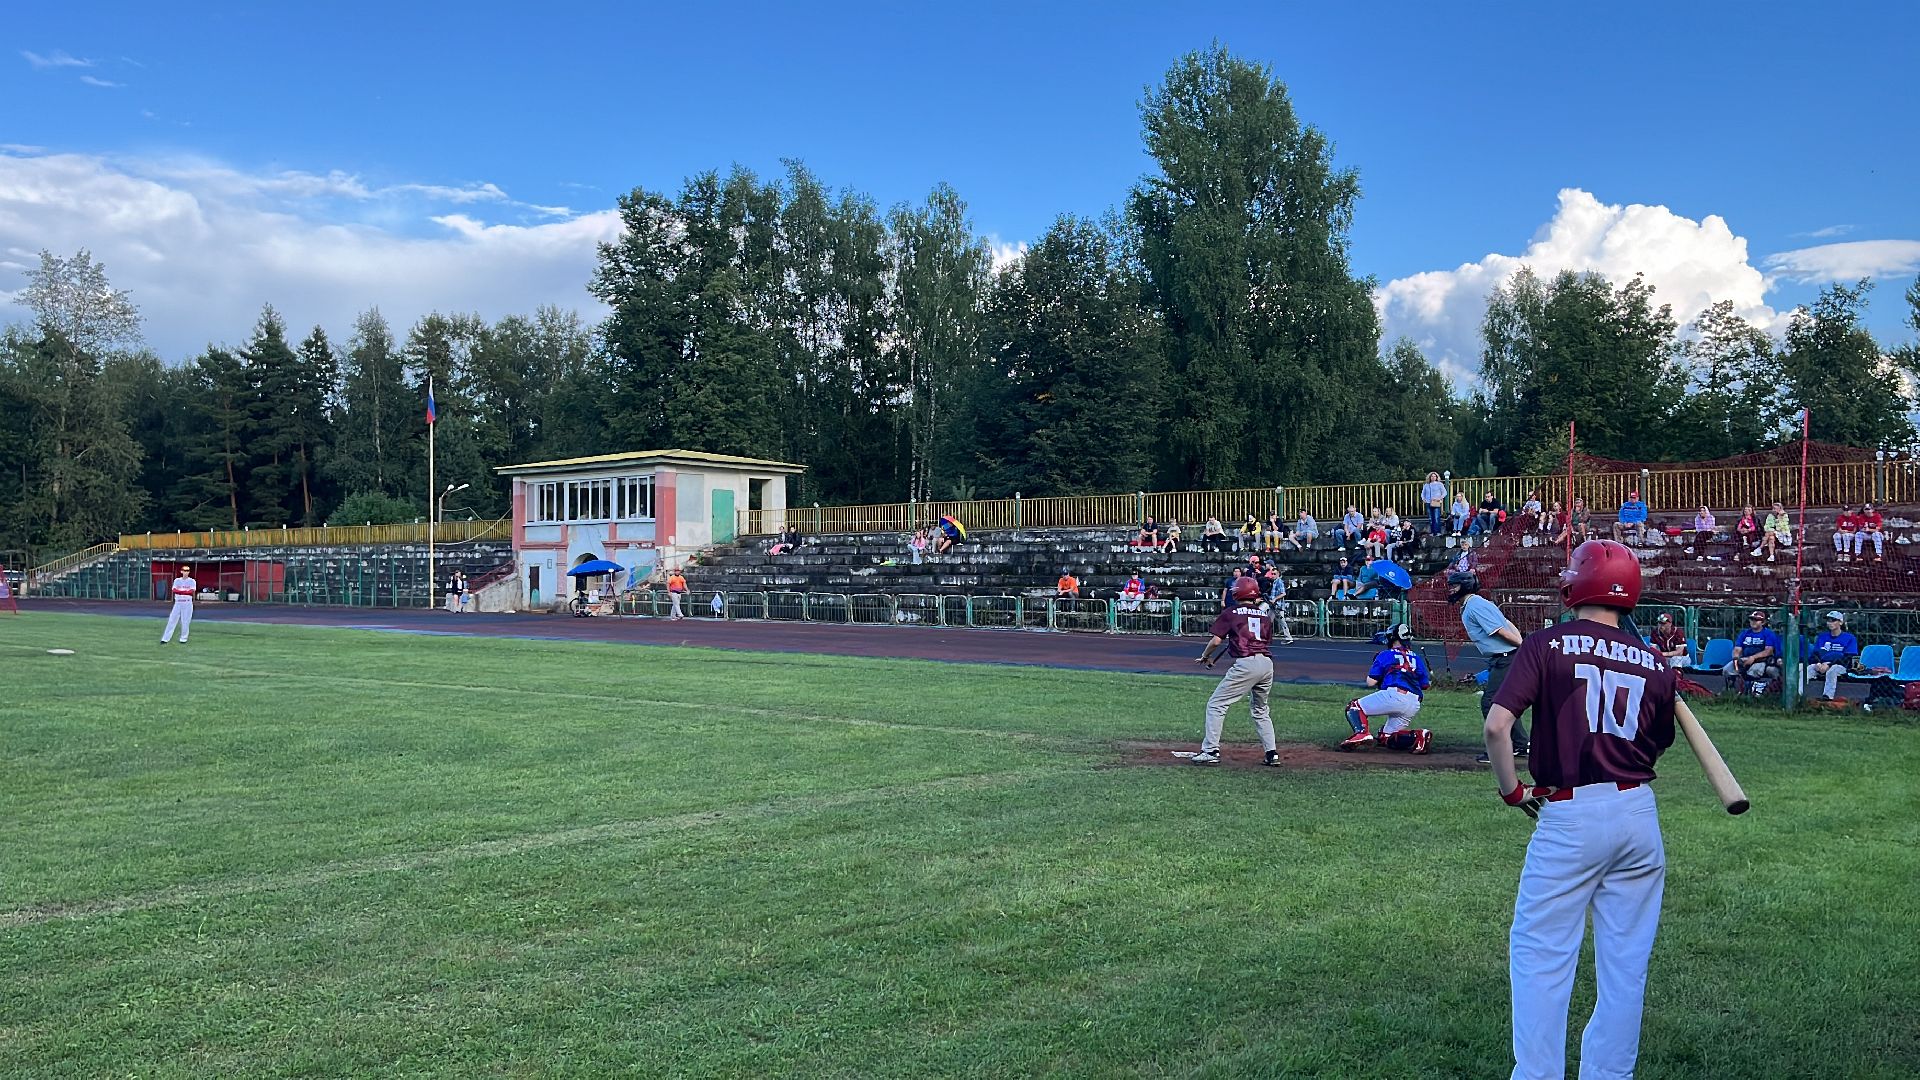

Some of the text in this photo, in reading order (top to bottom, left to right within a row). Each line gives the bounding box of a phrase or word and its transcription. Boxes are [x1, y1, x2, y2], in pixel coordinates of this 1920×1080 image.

[1247, 616, 1262, 641] 9
[1561, 634, 1656, 671] ДРАКОН
[1574, 663, 1647, 742] 10
